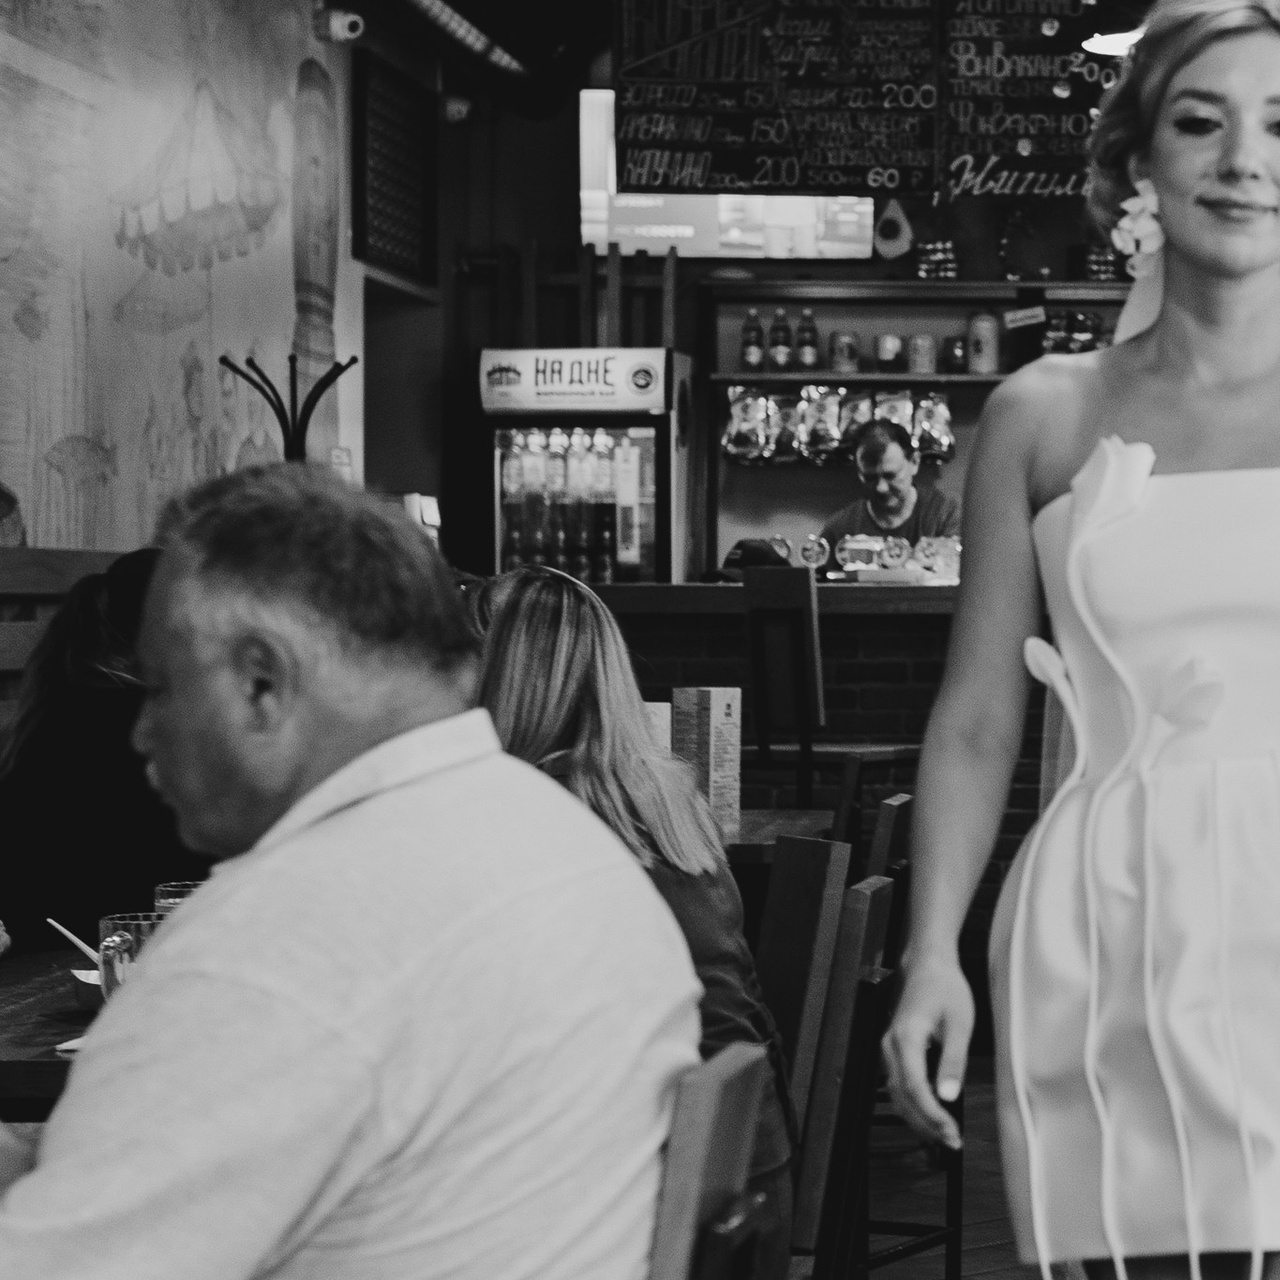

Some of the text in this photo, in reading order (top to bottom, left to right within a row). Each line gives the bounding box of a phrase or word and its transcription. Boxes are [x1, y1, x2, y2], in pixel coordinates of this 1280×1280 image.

[880, 82, 938, 109] 200
[752, 155, 801, 187] 200
[865, 165, 901, 190] 60
[534, 356, 563, 386] НА
[568, 355, 616, 387] ДНЕ
